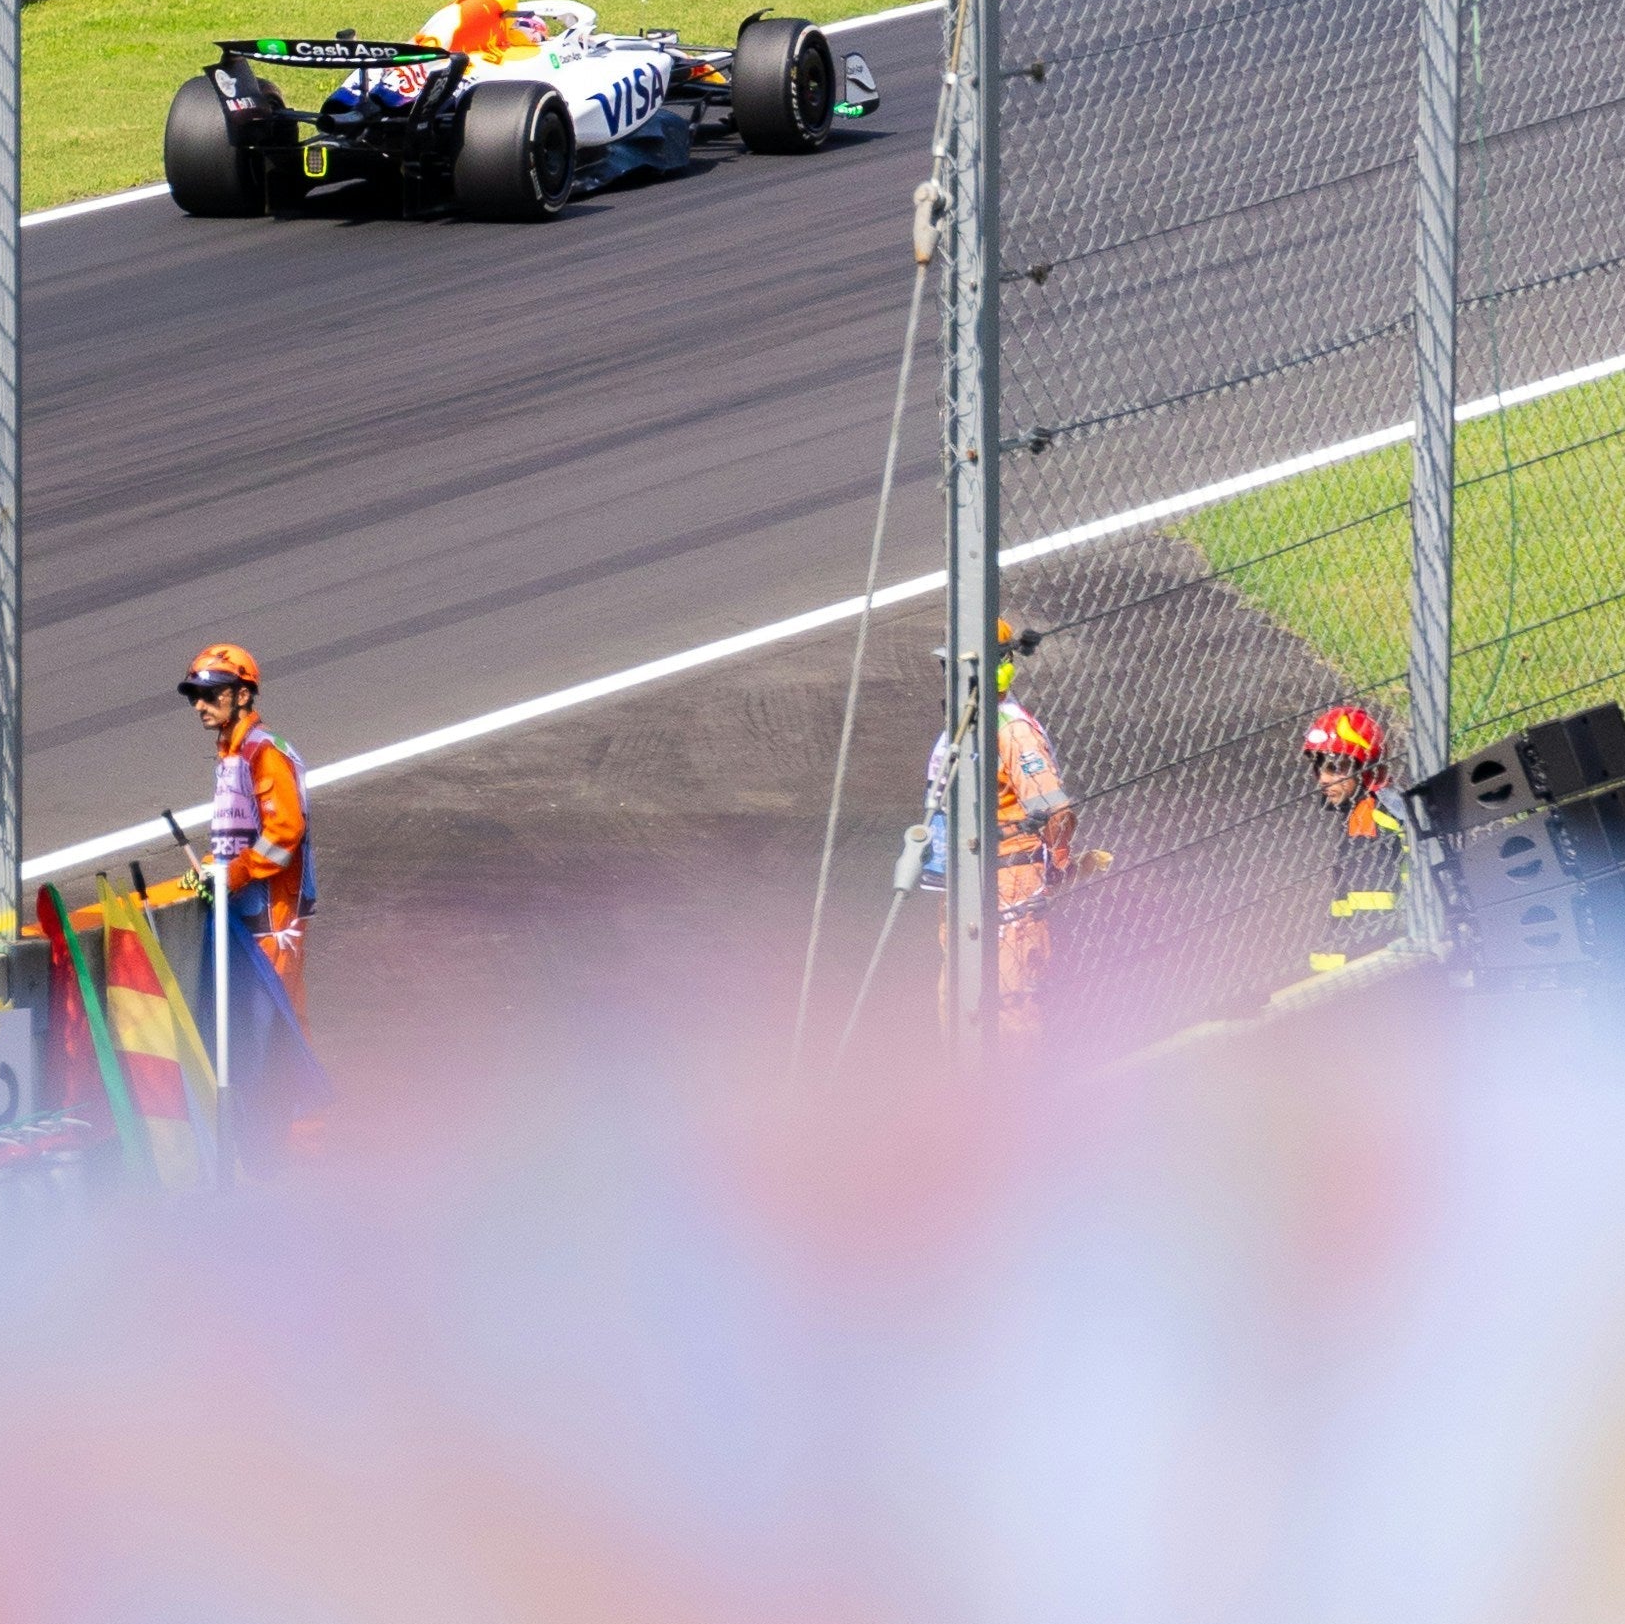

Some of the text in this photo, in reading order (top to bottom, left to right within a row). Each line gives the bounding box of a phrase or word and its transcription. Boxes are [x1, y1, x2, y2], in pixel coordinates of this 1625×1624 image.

[295, 42, 349, 57] Cash
[355, 43, 398, 59] App
[585, 62, 665, 137] VISA
